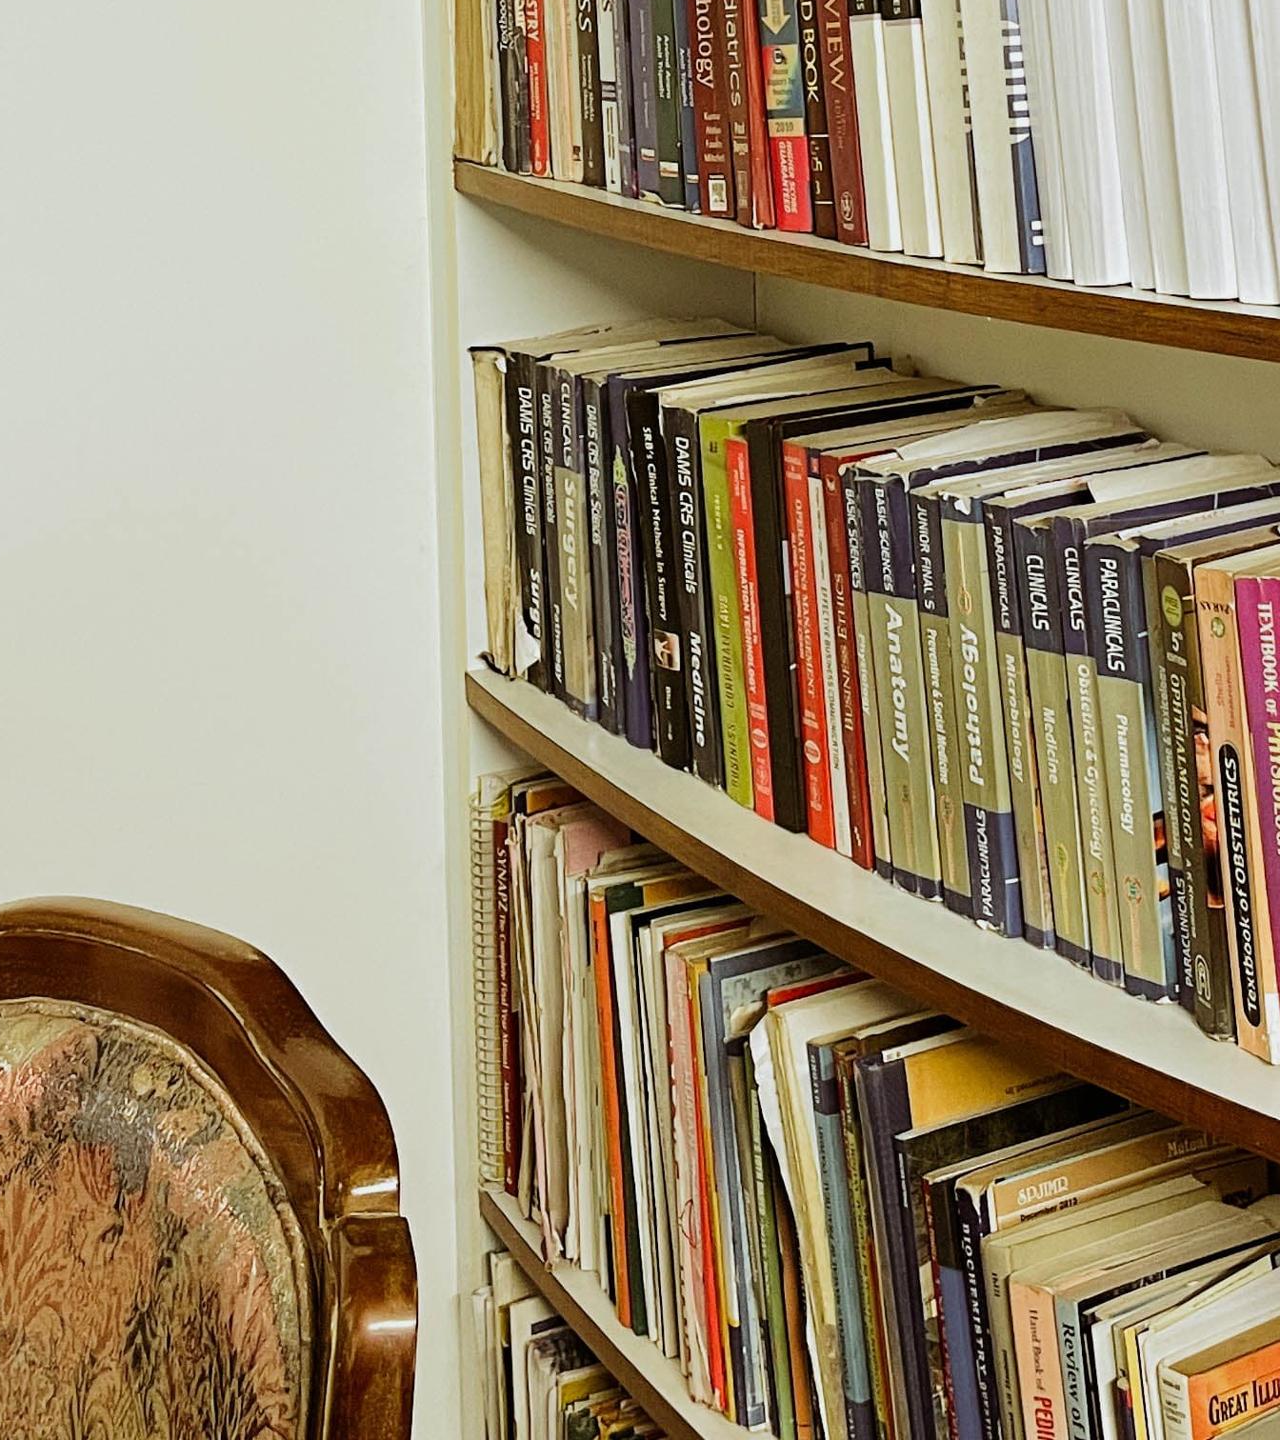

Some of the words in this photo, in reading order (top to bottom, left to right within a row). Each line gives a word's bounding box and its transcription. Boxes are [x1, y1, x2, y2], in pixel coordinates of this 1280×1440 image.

[802, 28, 820, 103] BOOK
[643, 427, 653, 459] SRB's
[675, 436, 691, 487] DAMS
[647, 462, 658, 505] Clinical
[680, 491, 693, 527] CRS
[653, 509, 662, 558] Methods
[682, 530, 697, 594] Clinicals
[992, 526, 1011, 628] PARACLINICALS
[1026, 554, 1049, 631] CLINICALS
[1064, 547, 1084, 631] CLINICALS
[1101, 559, 1125, 672] PARACLINICALS
[690, 632, 704, 747] Medicine
[885, 603, 910, 763] Anatomy
[1222, 757, 1246, 885] OBSTETRICS
[497, 848, 507, 912] SYNAPZ
[1236, 887, 1248, 911] of
[1238, 912, 1258, 1012] Textbook
[962, 1224, 986, 1379] BIOCHEMISTRY
[1062, 1324, 1080, 1401] Review
[1071, 1407, 1082, 1425] of
[1208, 1391, 1249, 1426] GREAT
